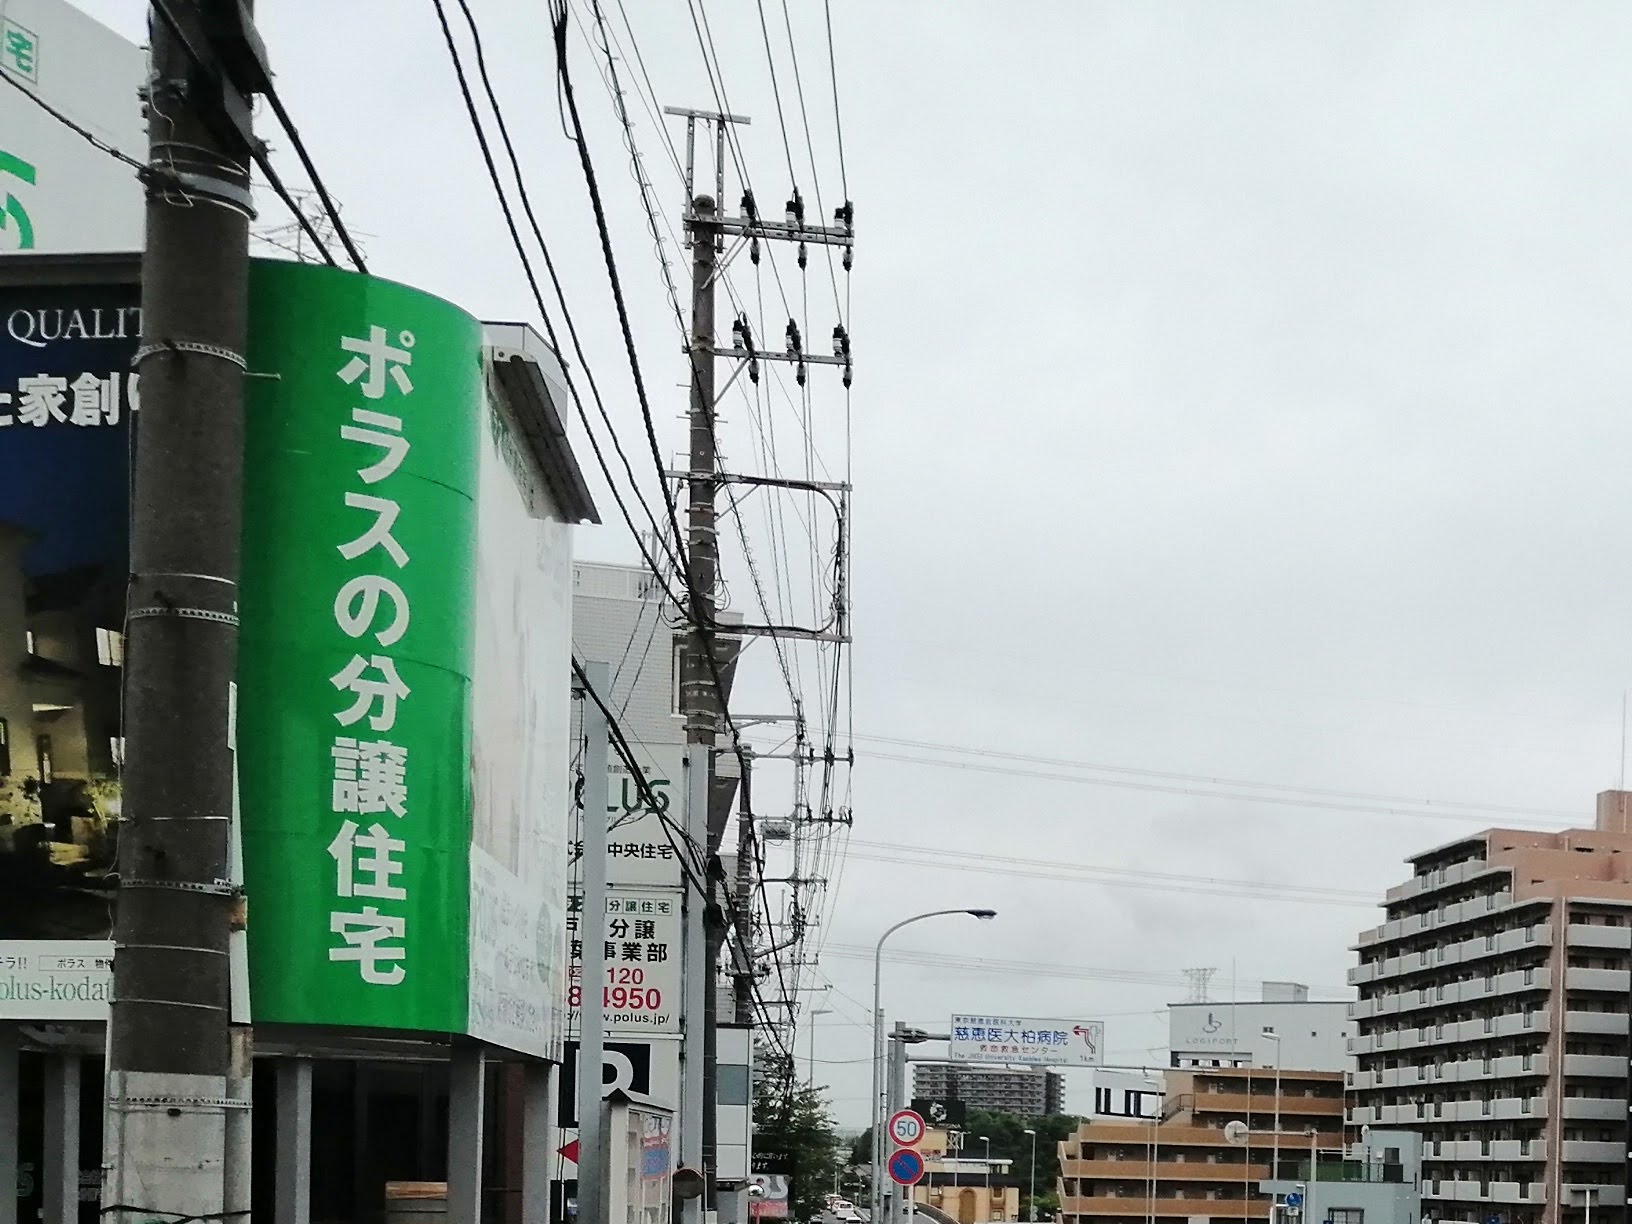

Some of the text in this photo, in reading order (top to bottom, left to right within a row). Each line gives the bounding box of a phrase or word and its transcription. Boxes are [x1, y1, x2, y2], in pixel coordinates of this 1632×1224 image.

[327, 324, 416, 987] ポラスの分譲住宅
[608, 900, 672, 914] 分譲住宅
[954, 1027, 1069, 1047] 慈恵医大柏病院
[1185, 1037, 1239, 1045] LOGIPORT
[896, 1121, 918, 1137] 50
